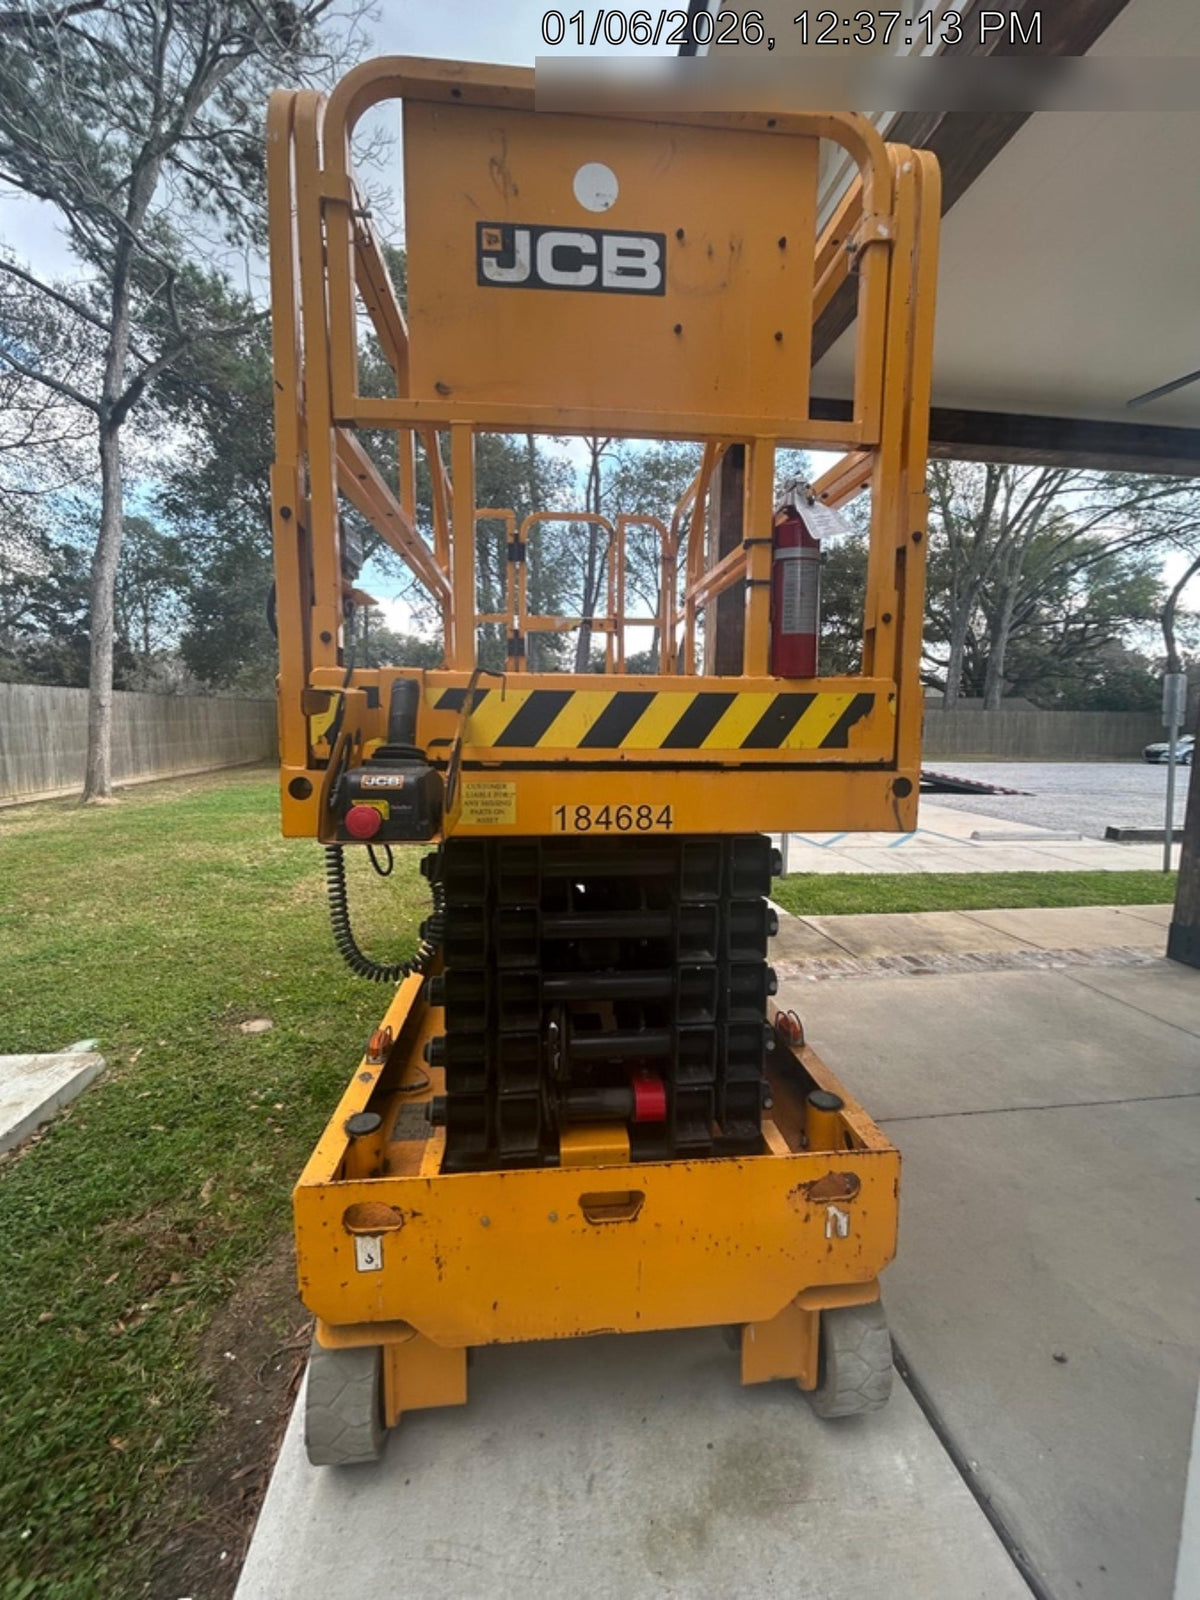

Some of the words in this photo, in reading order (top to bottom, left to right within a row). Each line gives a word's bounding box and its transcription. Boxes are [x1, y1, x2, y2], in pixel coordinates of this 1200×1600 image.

[481, 229, 663, 290] JCB
[364, 775, 400, 786] JCB
[554, 804, 673, 831] 184684
